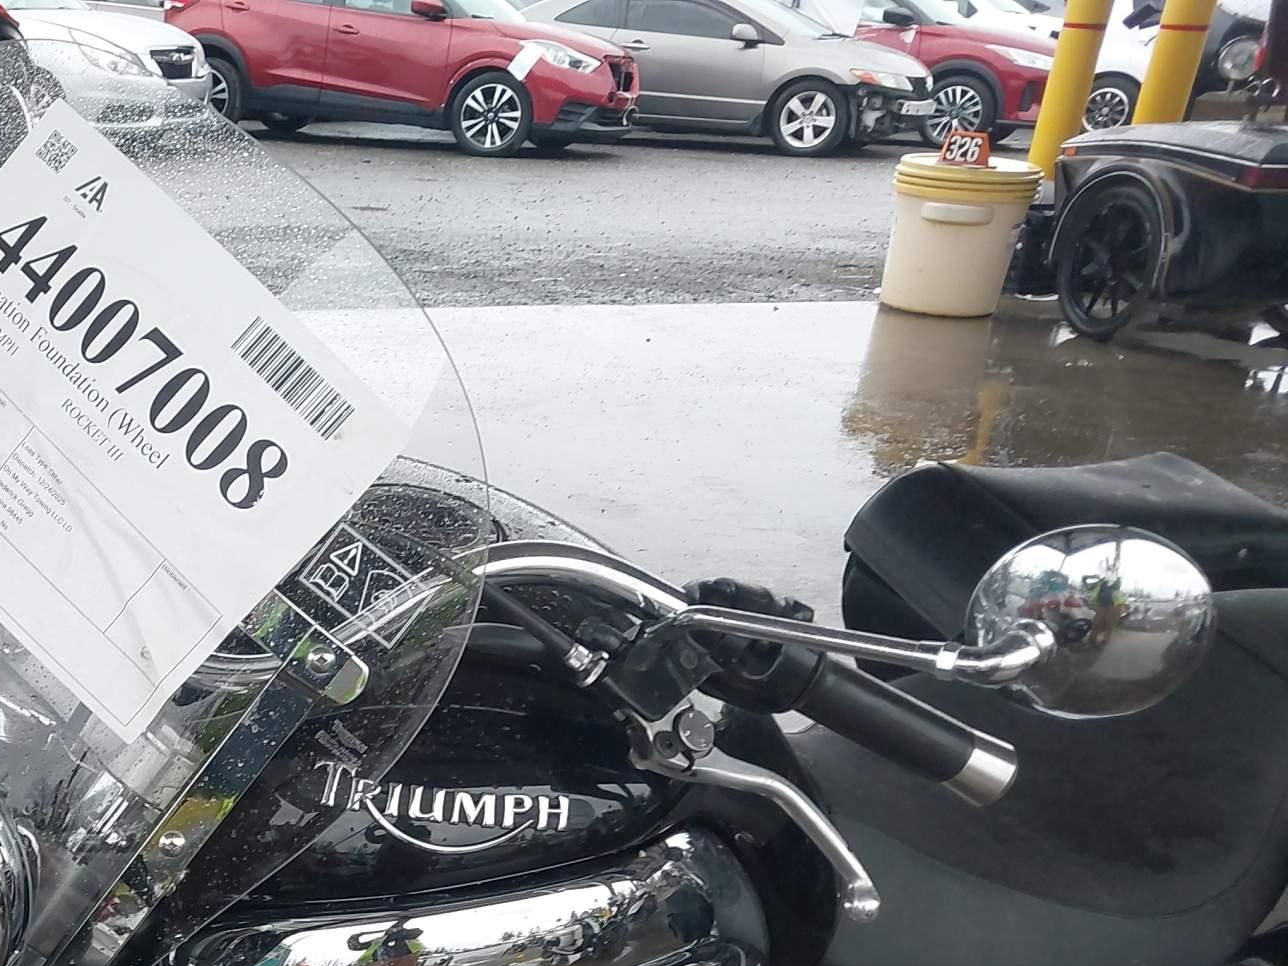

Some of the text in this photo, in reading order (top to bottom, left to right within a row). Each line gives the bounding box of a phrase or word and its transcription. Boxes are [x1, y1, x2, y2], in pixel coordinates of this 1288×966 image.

[945, 135, 983, 163] 326
[29, 326, 110, 413] Foundation
[106, 405, 171, 470] (Wheel
[61, 397, 112, 447] ROCKET
[106, 444, 126, 463] III
[12, 472, 20, 483] My
[20, 480, 33, 496] Way
[33, 493, 52, 515] Towing
[38, 477, 66, 506] 12/24/2025
[314, 761, 569, 832] TRIUMPH
